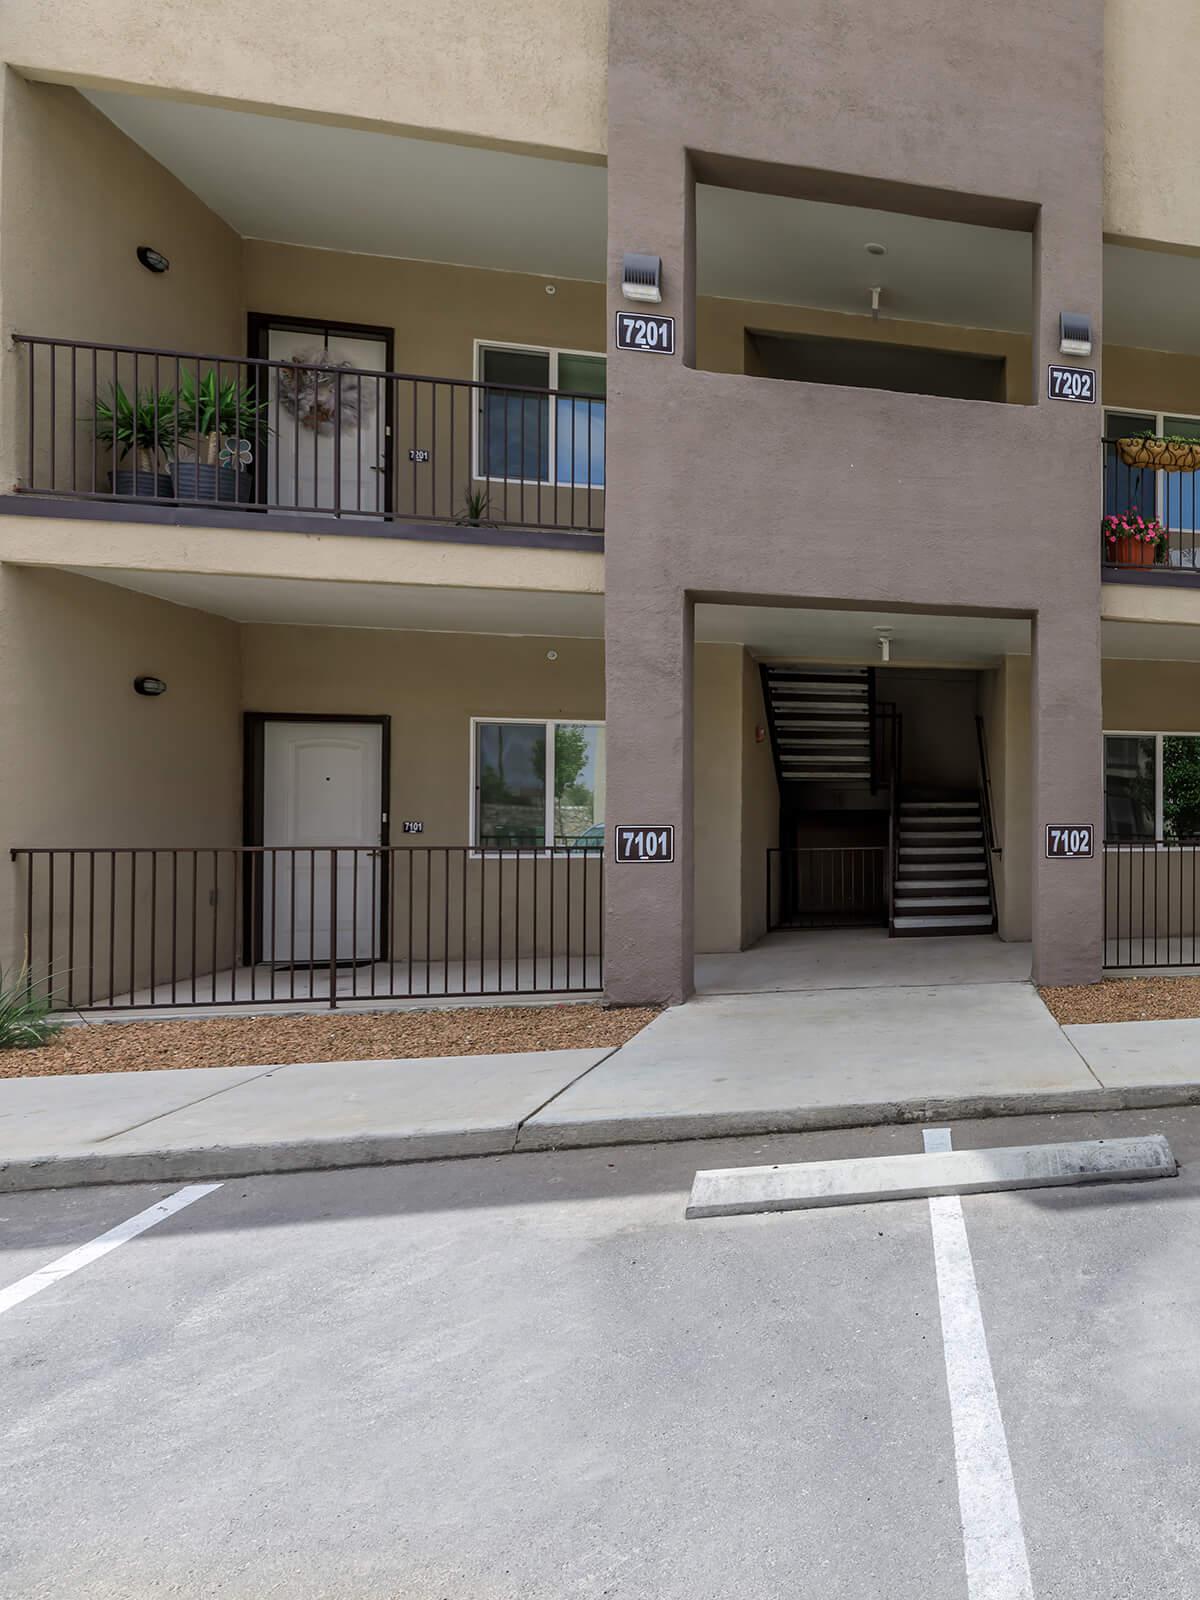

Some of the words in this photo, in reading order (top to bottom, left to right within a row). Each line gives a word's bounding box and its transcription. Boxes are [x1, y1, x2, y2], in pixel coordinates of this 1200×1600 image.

[623, 318, 668, 348] 7201
[1053, 371, 1091, 397] 7202
[405, 822, 422, 831] 7101
[623, 831, 667, 857] 7101
[1051, 830, 1089, 852] 7102
